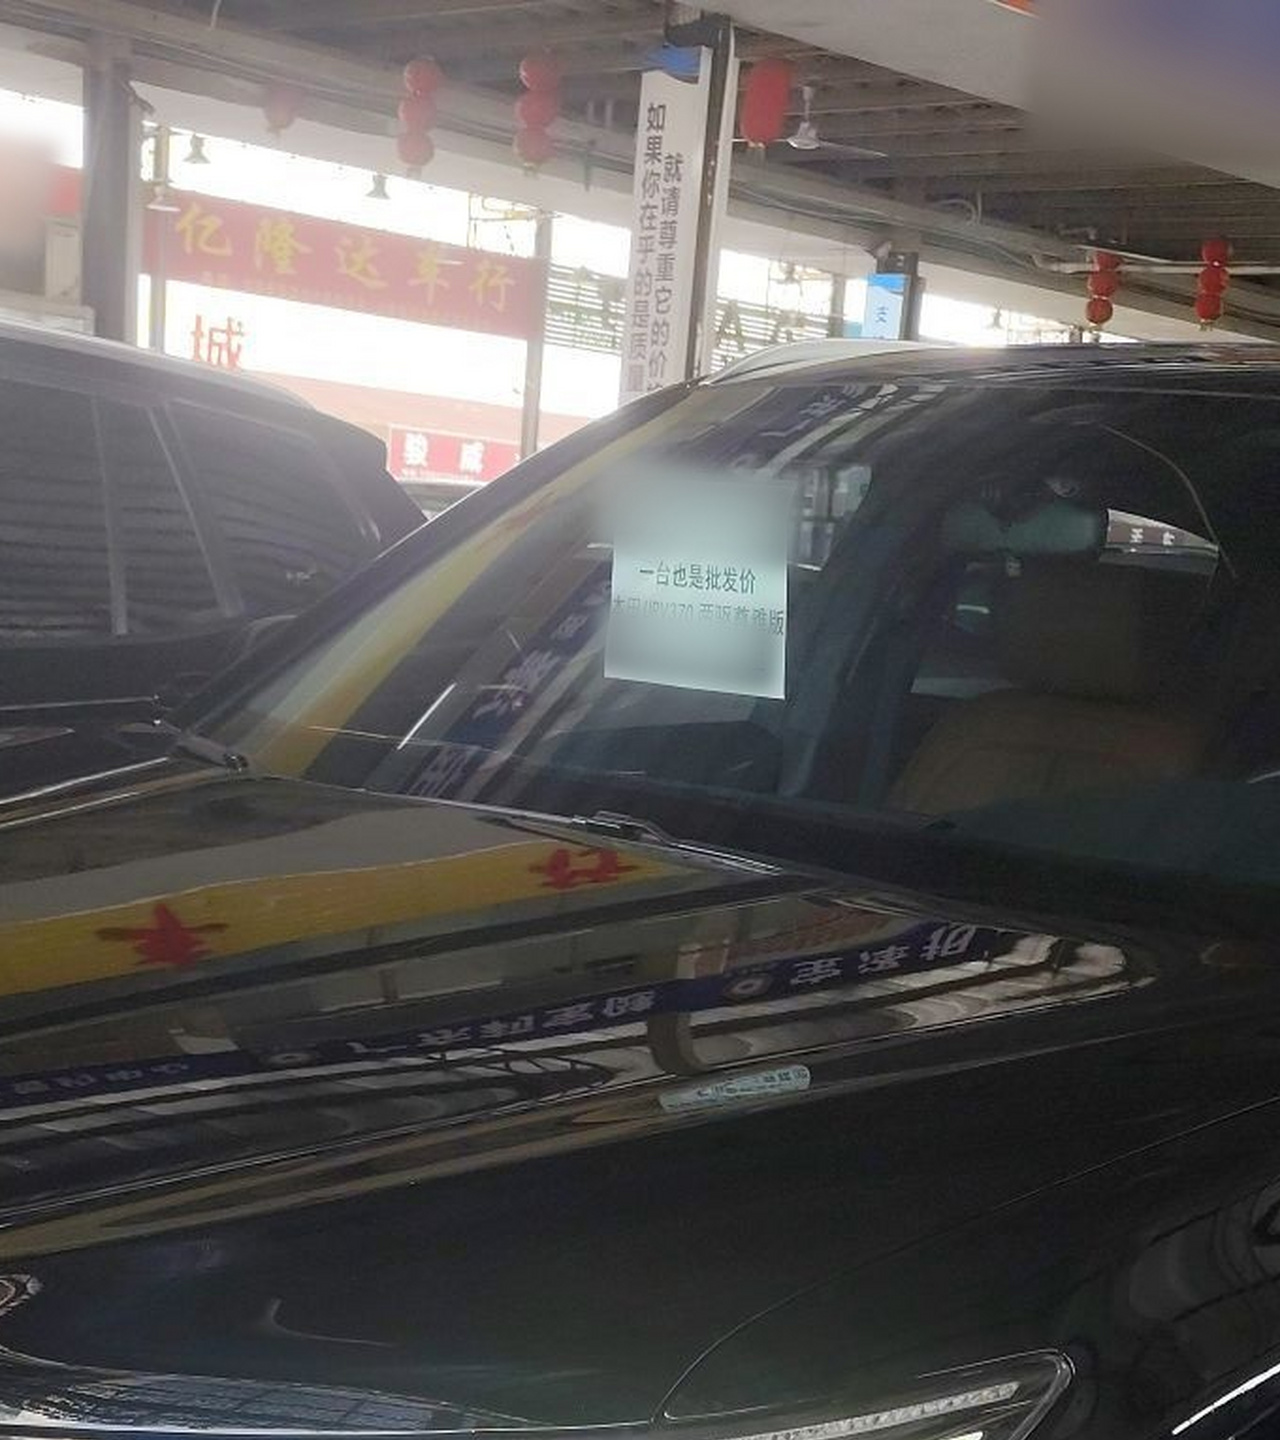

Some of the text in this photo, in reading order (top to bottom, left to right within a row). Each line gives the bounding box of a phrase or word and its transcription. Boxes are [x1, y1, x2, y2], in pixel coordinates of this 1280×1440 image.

[175, 203, 515, 313] 亿隆达车行
[646, 152, 684, 391] 就请尊重它的价
[639, 561, 756, 595] 一台也是批发价
